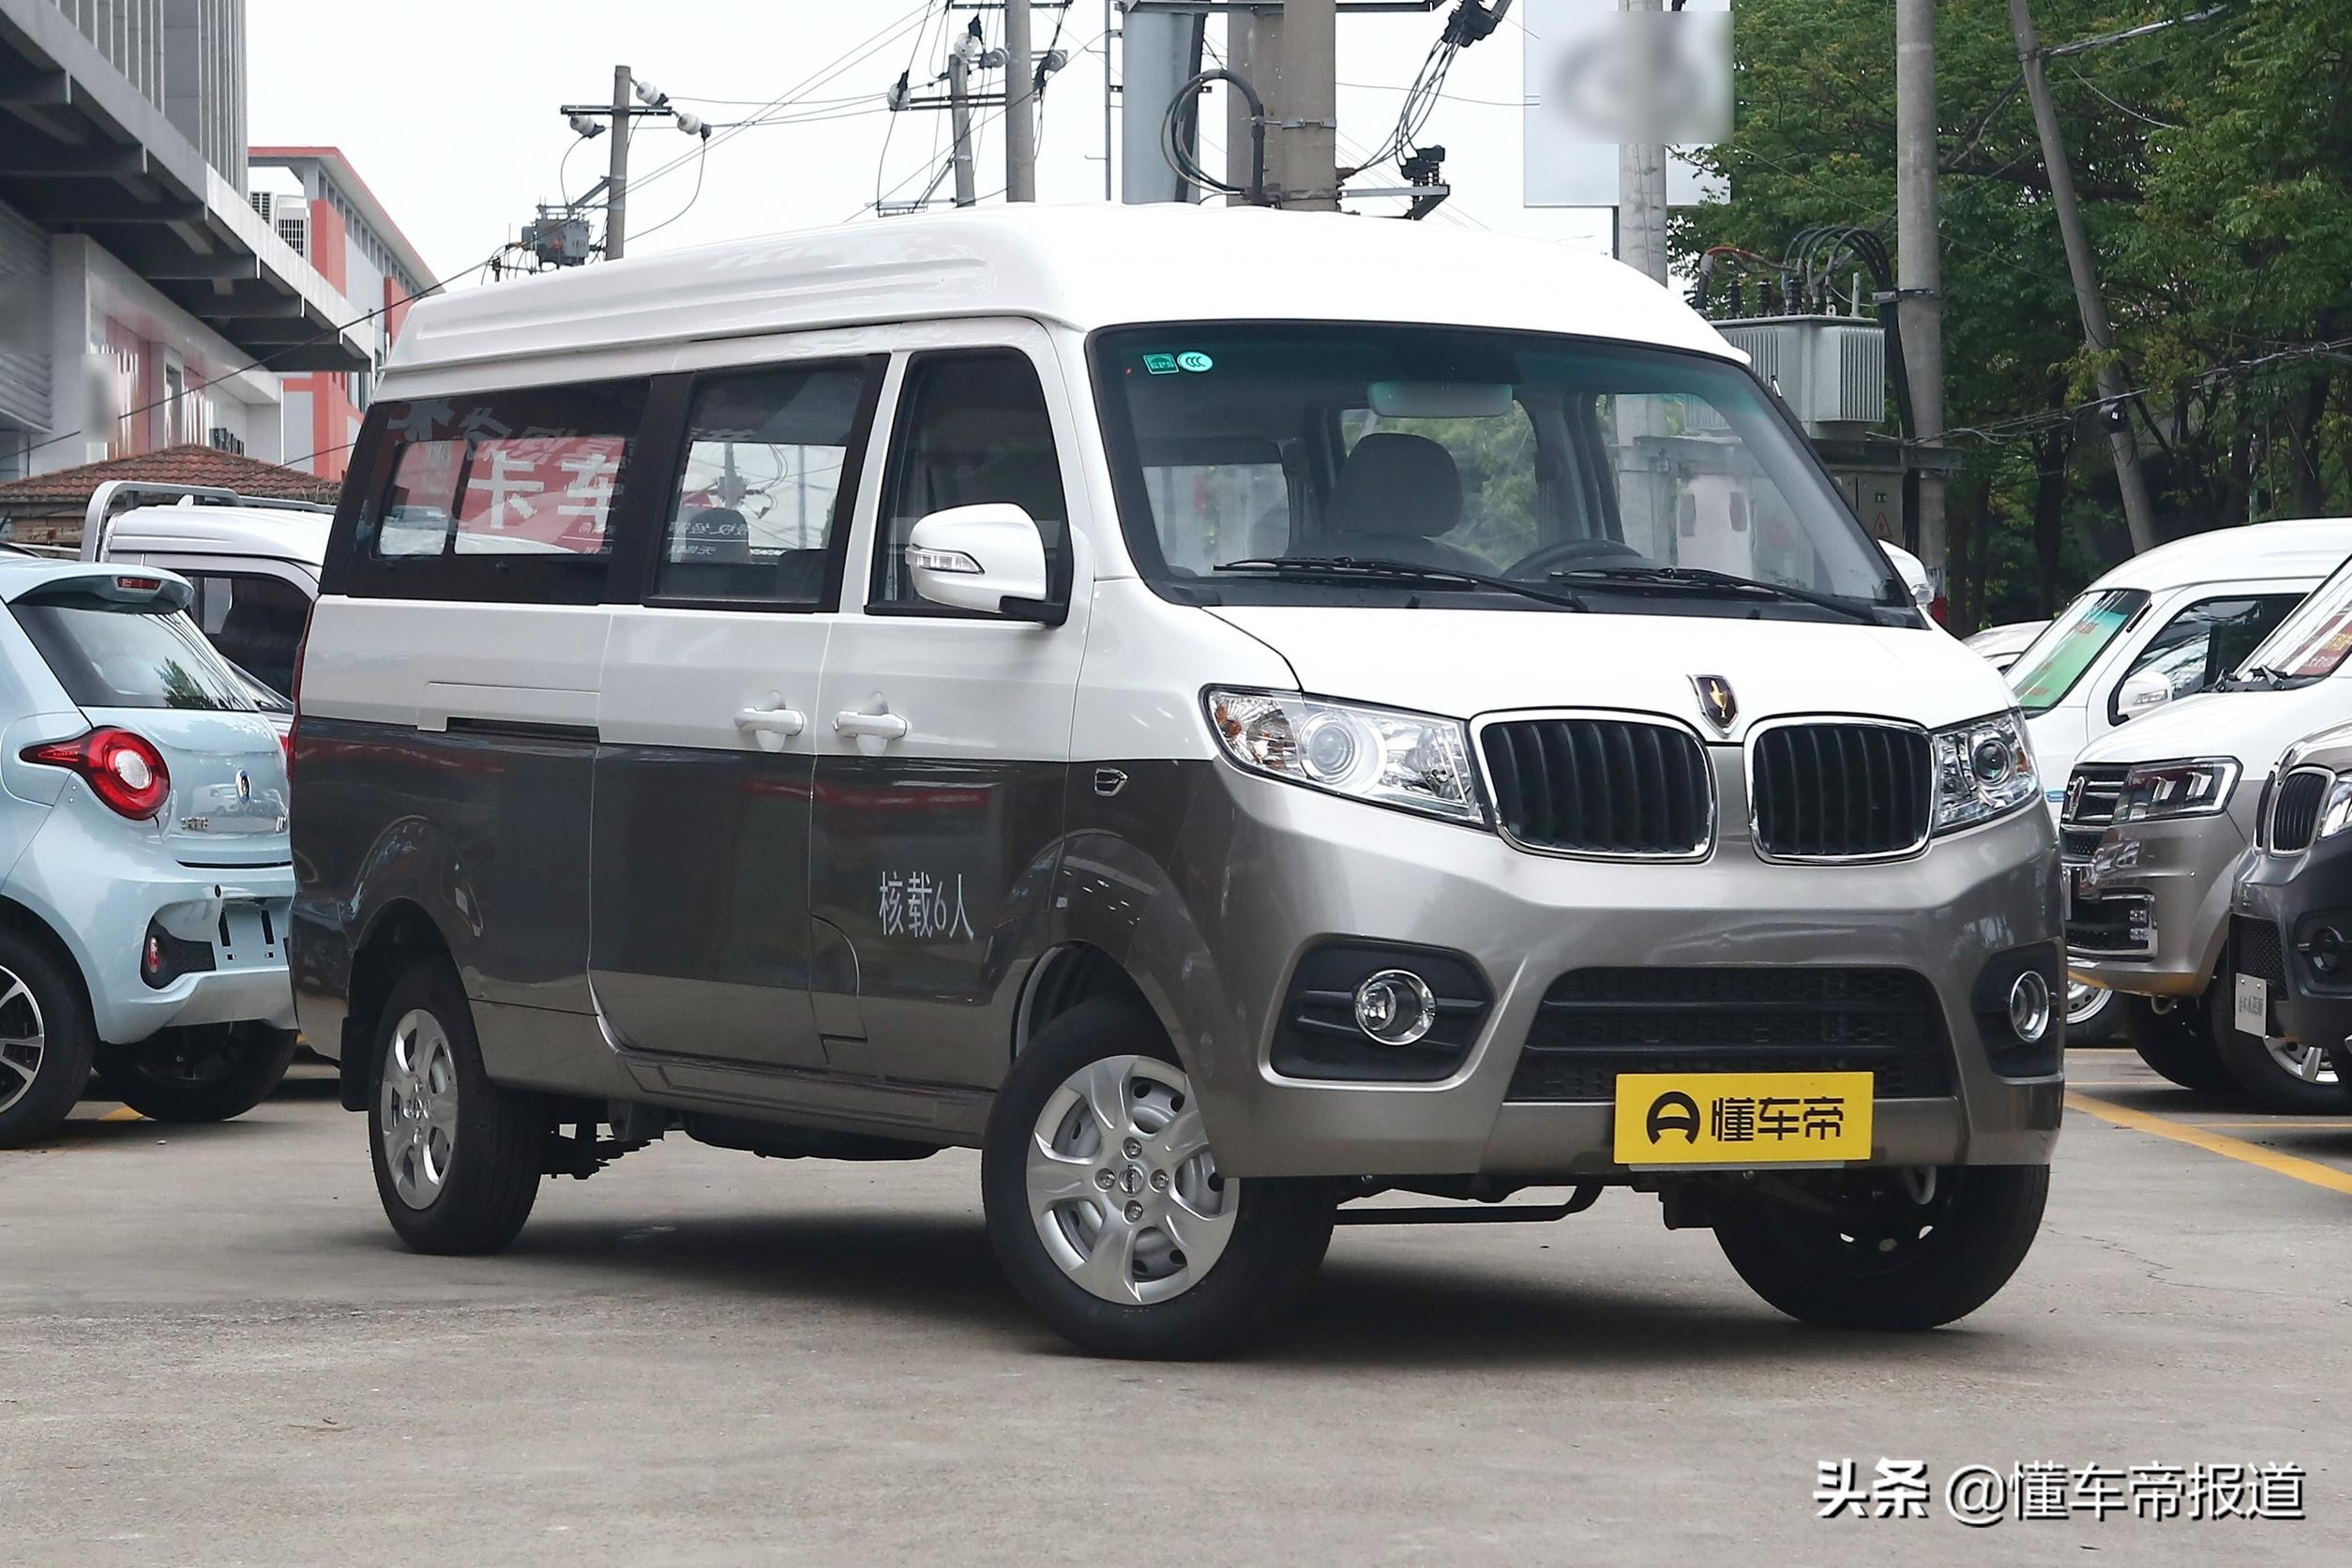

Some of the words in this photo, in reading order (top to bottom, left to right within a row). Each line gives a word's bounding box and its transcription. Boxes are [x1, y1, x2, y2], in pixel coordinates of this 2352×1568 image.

[879, 871, 974, 941] 核载6人
[1711, 1096, 1845, 1141] 懂车帝
